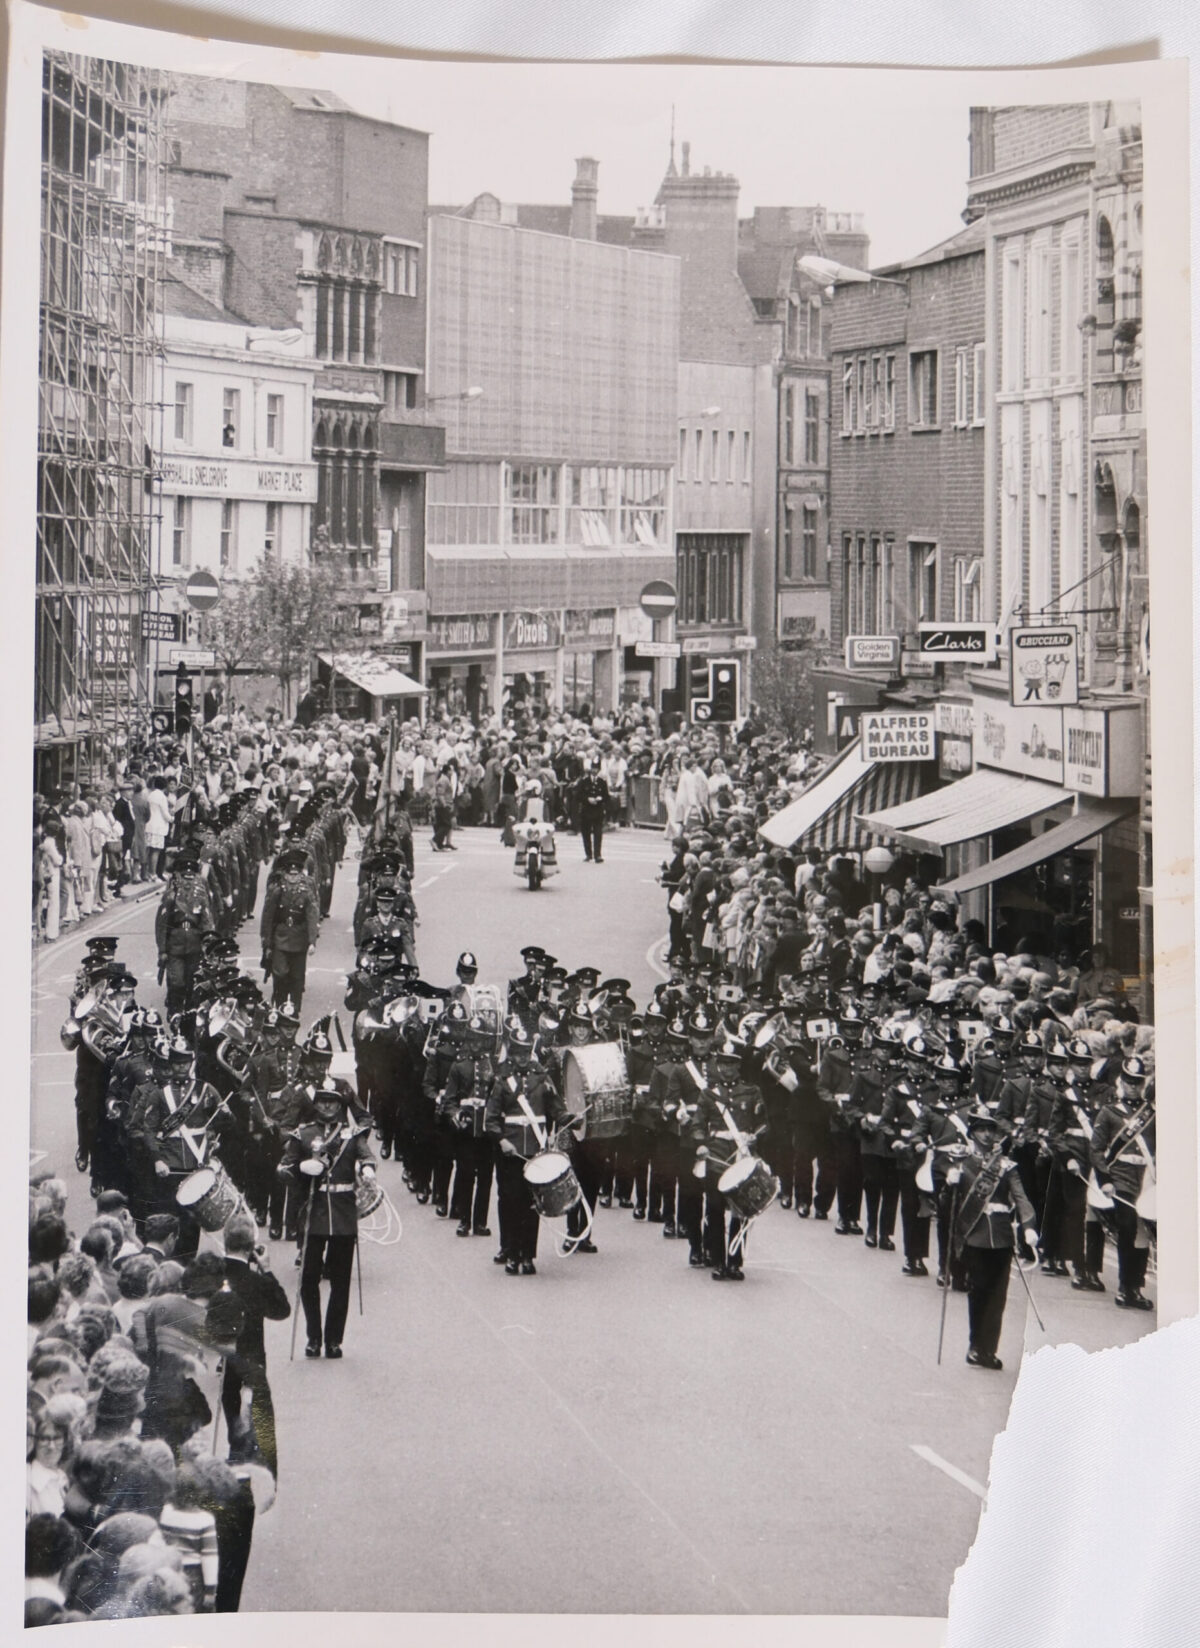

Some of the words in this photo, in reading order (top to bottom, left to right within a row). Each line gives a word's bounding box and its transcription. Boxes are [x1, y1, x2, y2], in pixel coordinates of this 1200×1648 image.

[258, 470, 282, 491] MARKET
[284, 472, 303, 493] PLACE
[517, 619, 548, 643] Dixons
[857, 643, 890, 651] Golden
[924, 632, 982, 651] Clarks
[1019, 634, 1069, 647] BRUCCIANI
[857, 651, 890, 660] Virginia
[868, 717, 929, 729] ALFRED
[869, 731, 929, 743] MARKS
[869, 745, 930, 758] BUREAU
